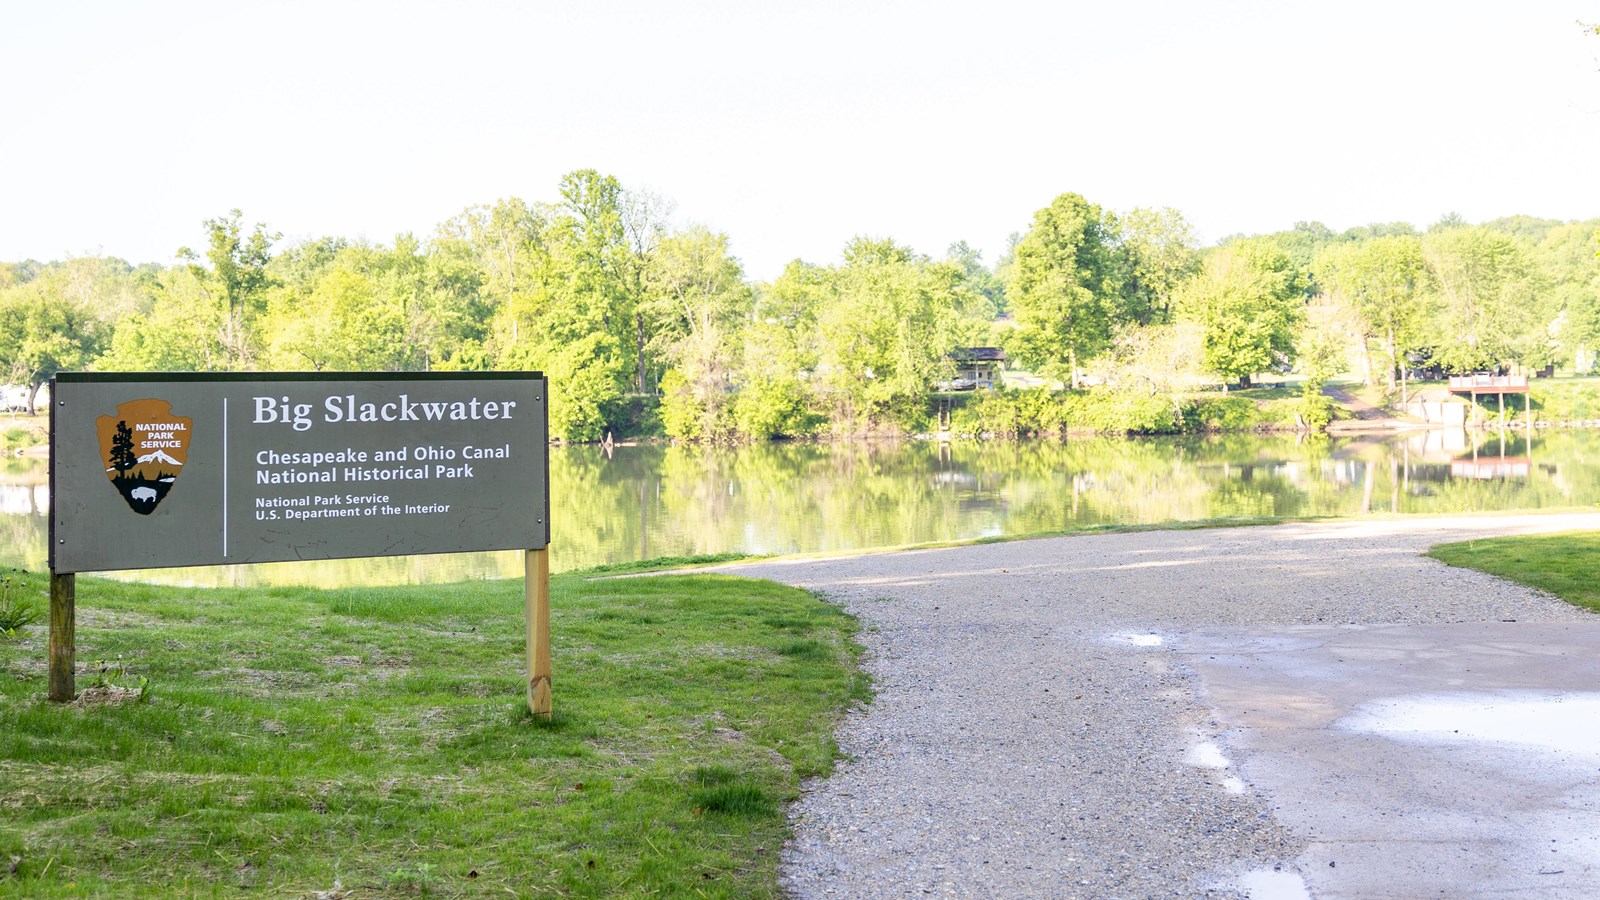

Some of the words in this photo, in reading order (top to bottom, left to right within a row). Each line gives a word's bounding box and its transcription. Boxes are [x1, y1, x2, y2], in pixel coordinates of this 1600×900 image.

[253, 396, 312, 431] Big
[325, 395, 516, 422] Slackwater
[136, 423, 186, 431] NATIONAL
[257, 448, 367, 467] Chesapeake
[375, 447, 406, 461] and
[414, 446, 455, 460] Ohio
[463, 444, 509, 459] Canal
[257, 468, 336, 484] National
[345, 465, 428, 481] Historical
[436, 464, 473, 478] Park
[256, 496, 309, 507] National
[315, 495, 341, 505] Park
[346, 494, 389, 504] Service
[256, 510, 280, 520] U.S.
[286, 508, 360, 520] Department
[364, 505, 377, 515] of
[381, 505, 401, 514] the
[406, 503, 450, 513] Interior
